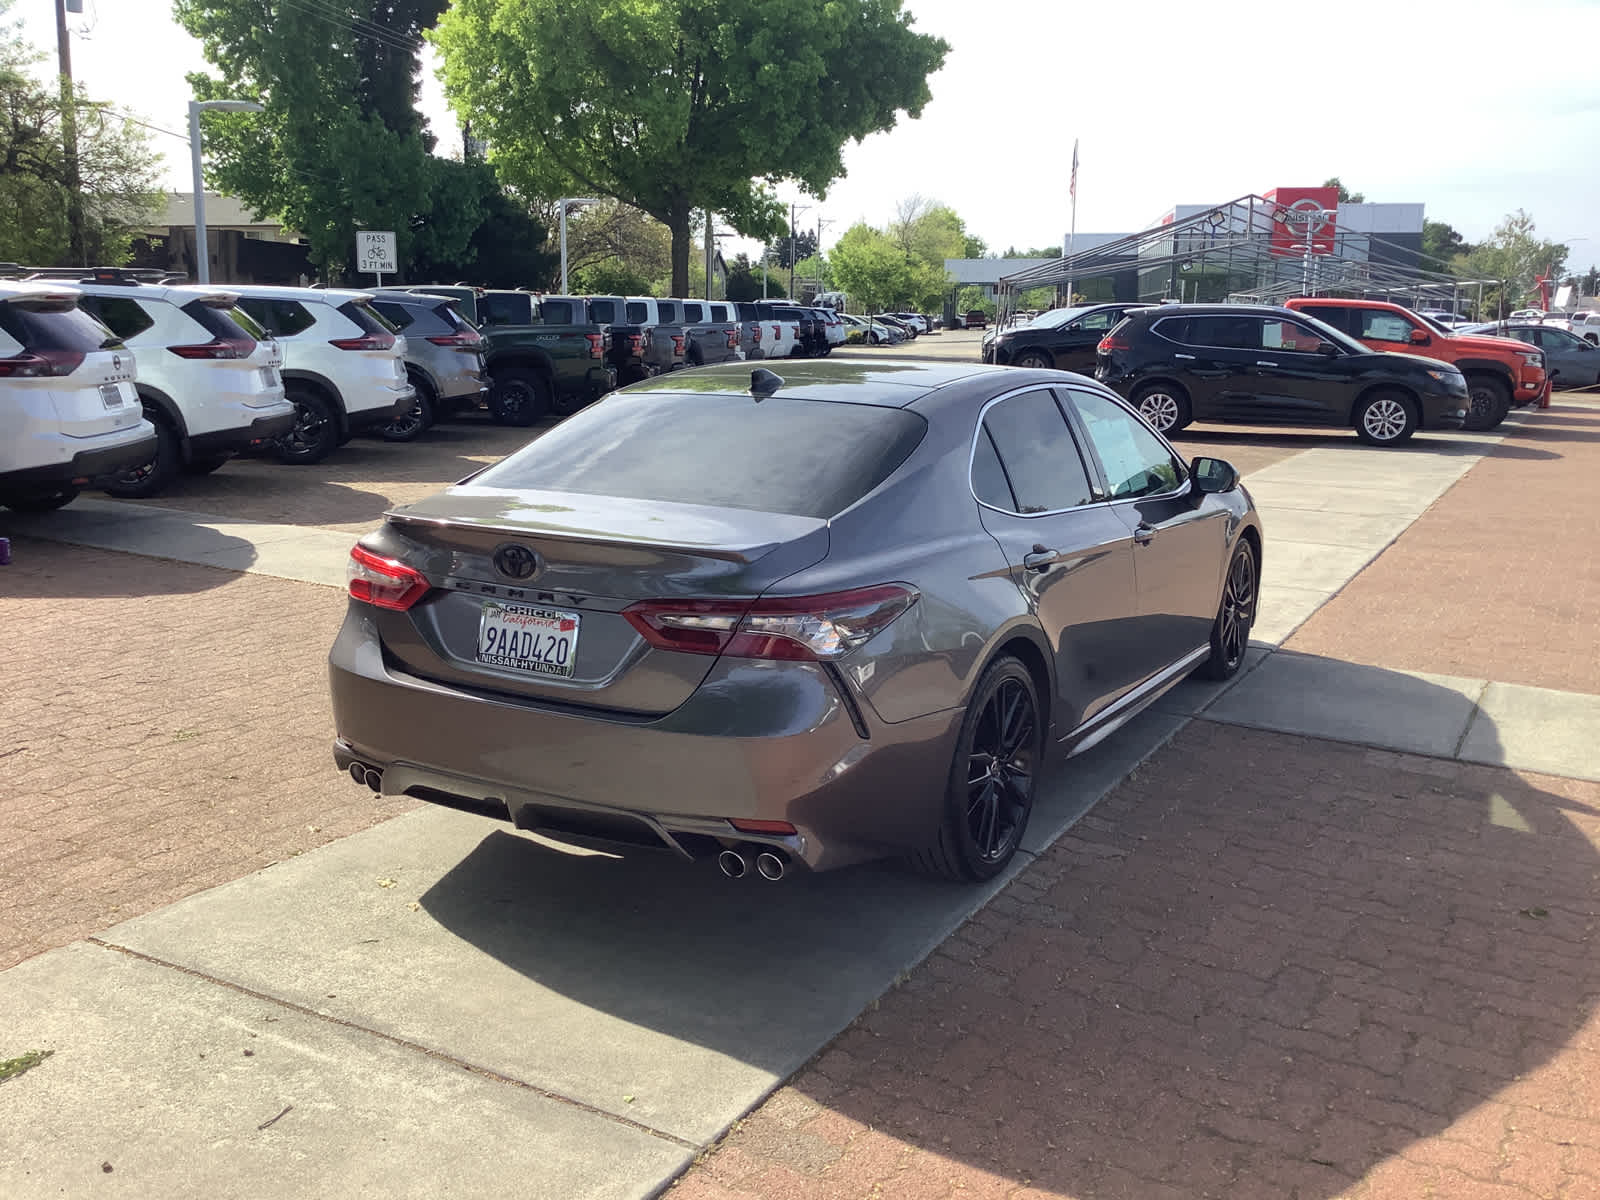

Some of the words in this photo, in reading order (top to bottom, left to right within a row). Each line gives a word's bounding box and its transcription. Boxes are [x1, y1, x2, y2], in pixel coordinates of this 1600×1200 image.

[367, 235, 385, 243] PASS
[361, 259, 367, 269] 3
[369, 261, 378, 269] FT
[380, 261, 393, 270] MIN
[455, 581, 587, 605] CAMRY
[506, 604, 554, 619] CHICO
[503, 613, 554, 629] California
[484, 626, 569, 665] 9AAD420
